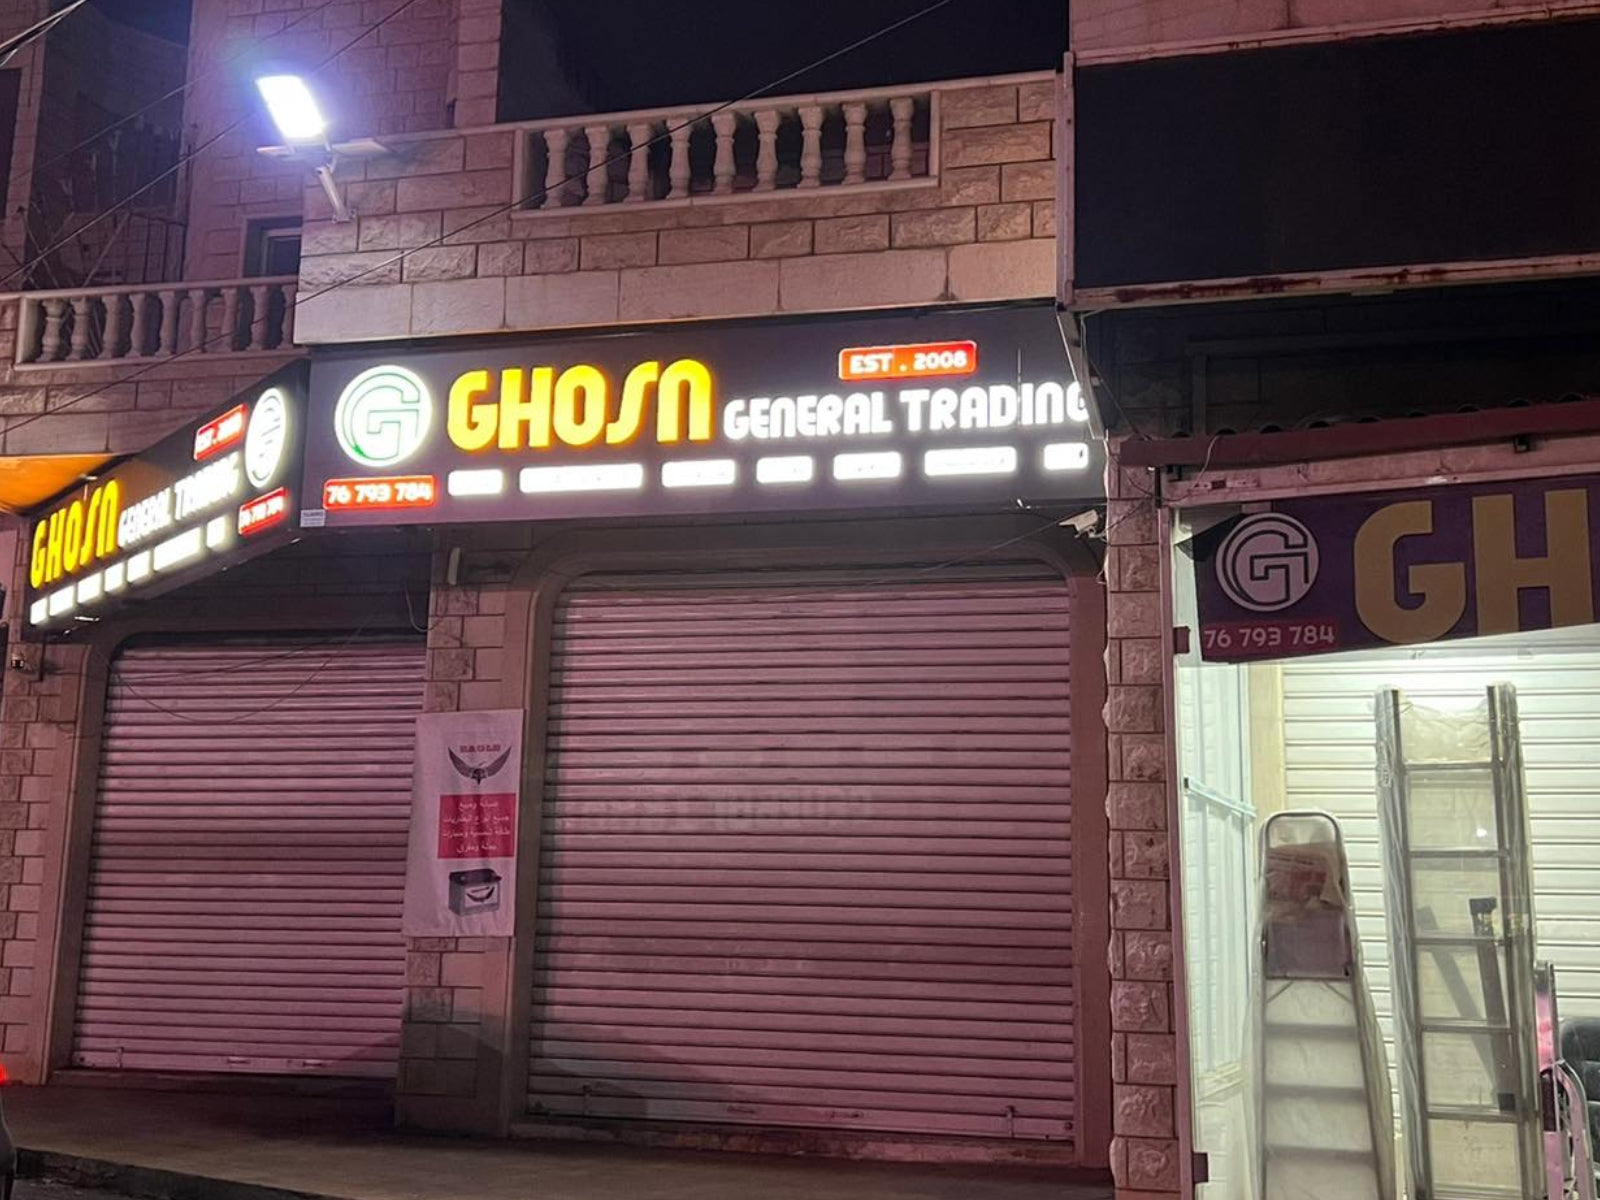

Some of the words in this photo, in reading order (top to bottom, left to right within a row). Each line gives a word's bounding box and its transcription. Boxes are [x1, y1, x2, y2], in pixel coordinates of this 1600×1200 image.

[849, 352, 894, 374] EST
[913, 350, 967, 370] 2008
[447, 358, 712, 450] GHOSN
[723, 391, 892, 440] GENERAL
[899, 381, 1089, 431] TRADING
[327, 485, 351, 504] 76
[354, 483, 391, 503] 793
[394, 481, 432, 502] 784
[30, 479, 119, 589] GHOSN
[1203, 629, 1232, 649] 76
[1239, 627, 1282, 647] 793
[1289, 625, 1335, 645] 784
